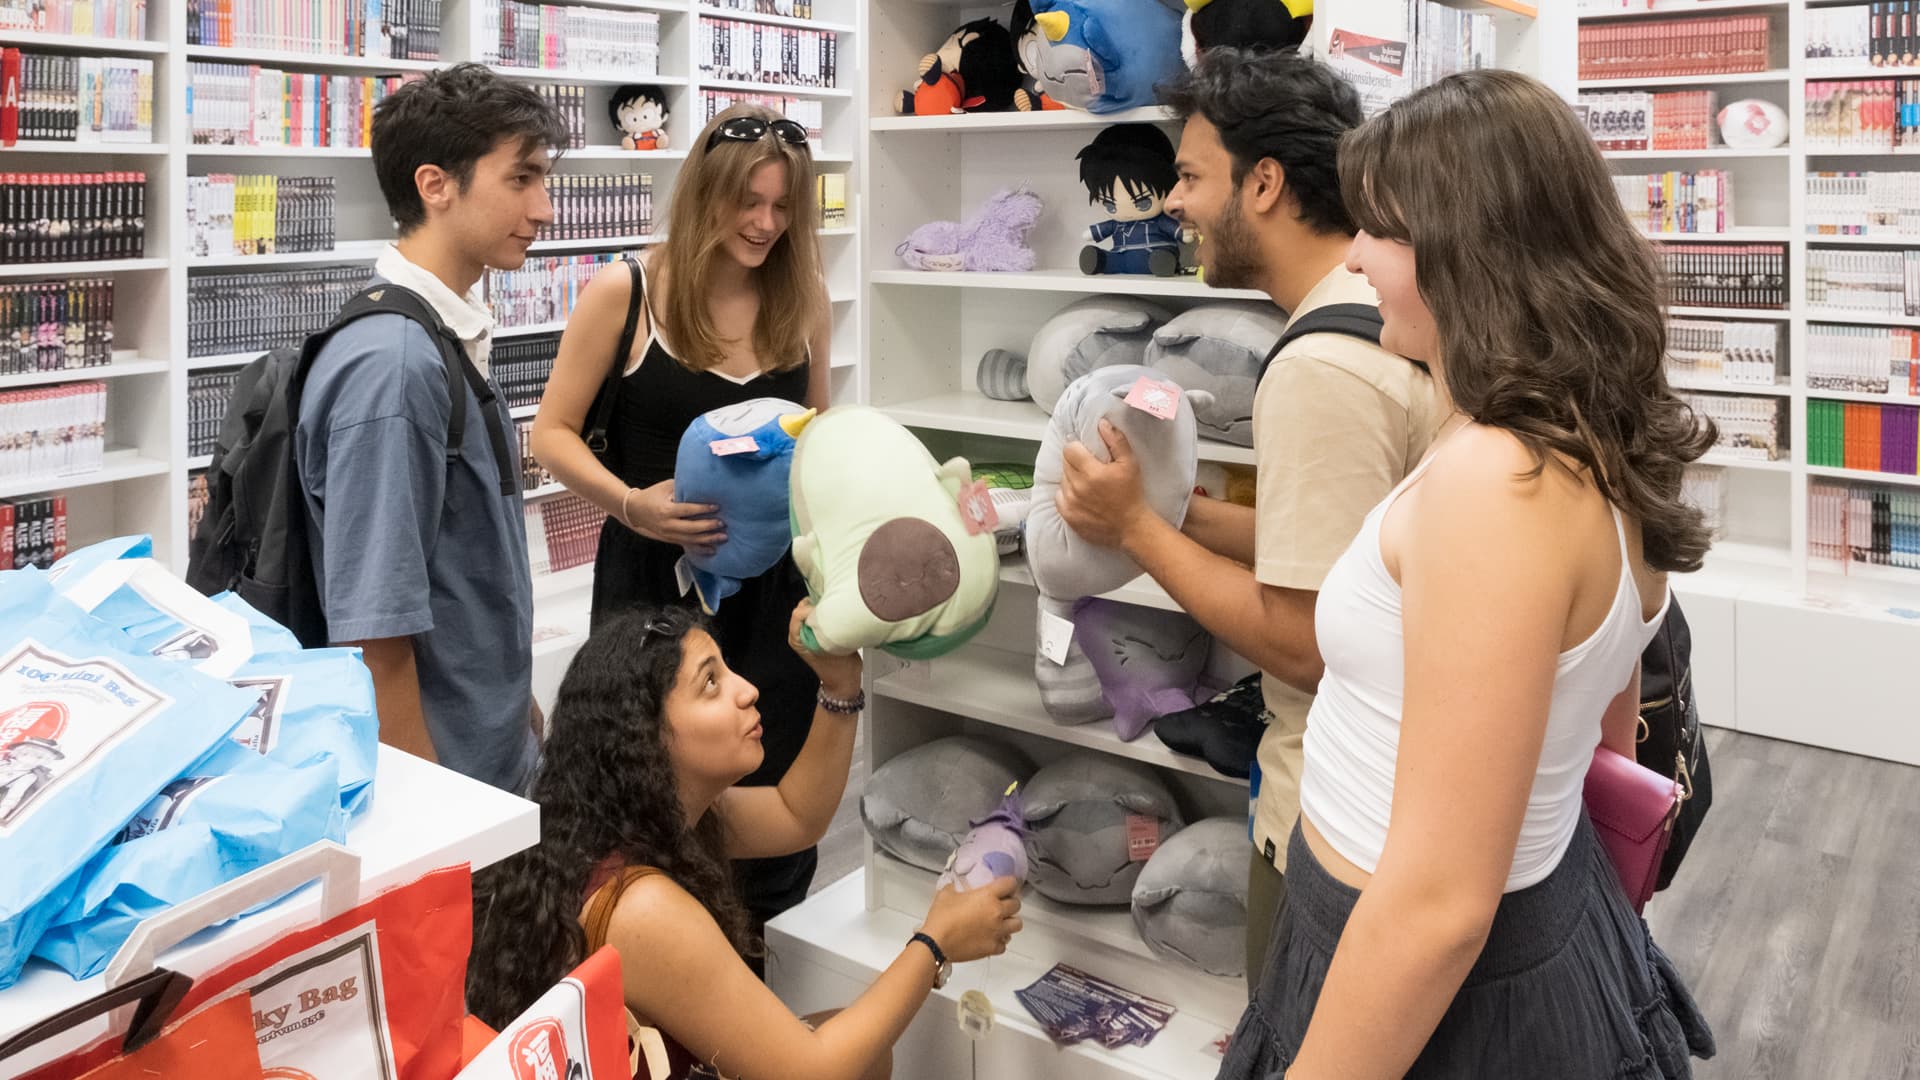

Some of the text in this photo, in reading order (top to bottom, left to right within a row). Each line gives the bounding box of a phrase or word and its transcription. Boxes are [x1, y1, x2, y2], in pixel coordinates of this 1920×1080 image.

[5, 76, 17, 107] A
[3, 526, 14, 552] ALICE
[16, 522, 28, 549] ALICE
[31, 520, 41, 547] ALICE
[44, 518, 54, 544] ALICE
[55, 516, 66, 542] ALICE
[252, 976, 358, 1031] ky Bag
